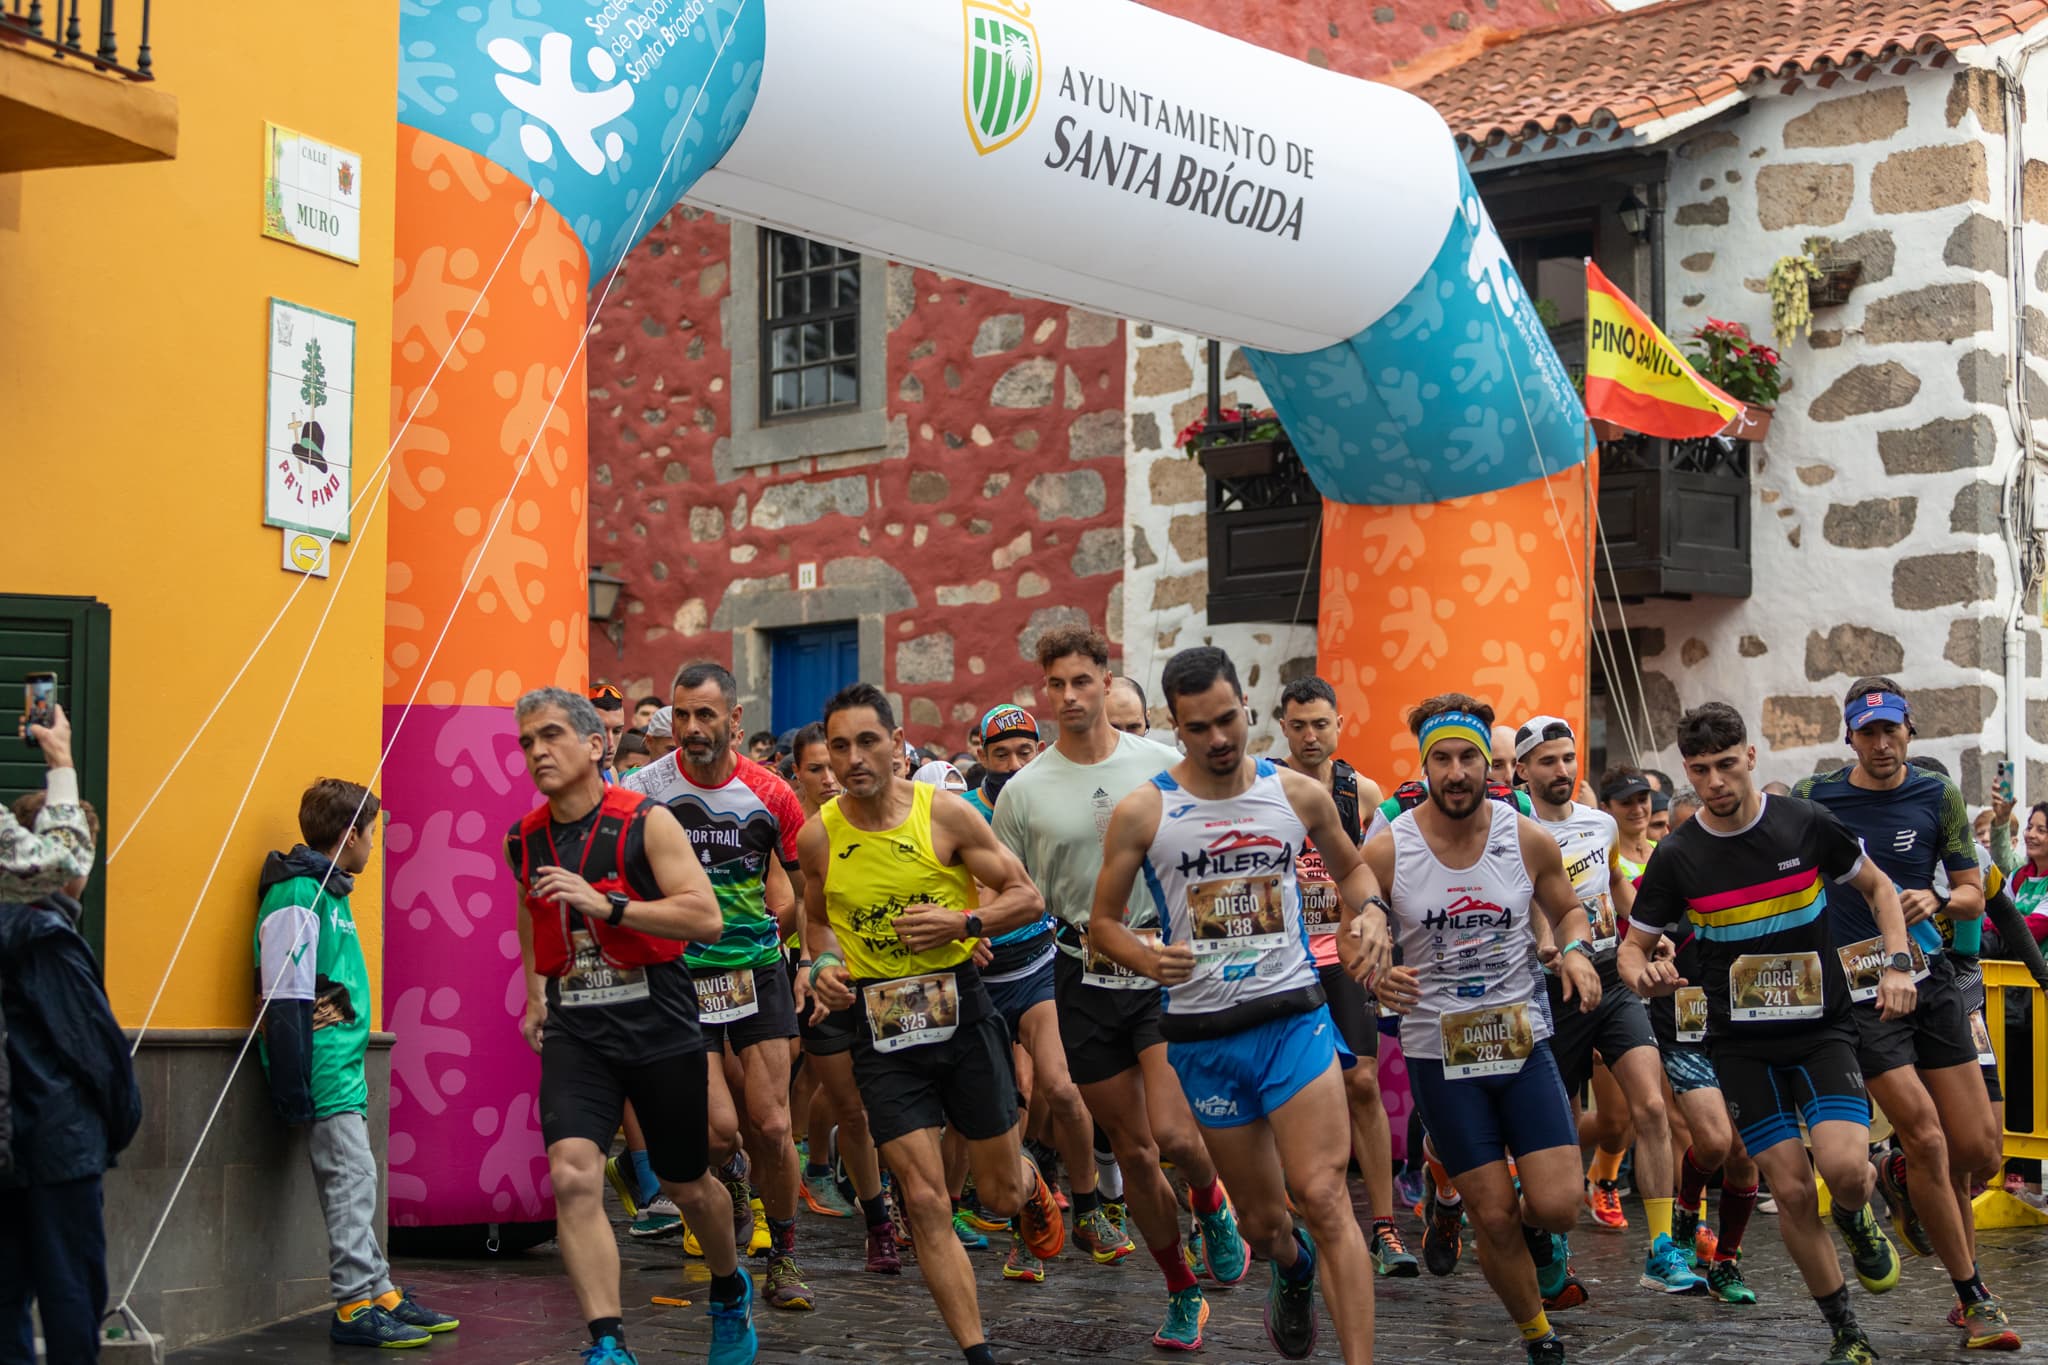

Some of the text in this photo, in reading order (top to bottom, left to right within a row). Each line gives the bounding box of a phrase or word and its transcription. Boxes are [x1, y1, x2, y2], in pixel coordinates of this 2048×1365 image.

[584, 0, 634, 36] Socie
[611, 34, 632, 57] de
[625, 0, 705, 84] Santa Brígida
[1058, 65, 1315, 181] AYUNTAMIENTO DE
[301, 145, 328, 166] CALLE
[1043, 114, 1305, 242] SANTA BRÍGIDA
[296, 202, 341, 238] MURO
[1591, 318, 1636, 359] PINO
[994, 710, 1026, 731] WTF!
[709, 829, 742, 848] TRAIL
[1175, 841, 1292, 878] HILERA
[1566, 847, 1605, 883] porty
[1214, 893, 1260, 917] DIEGO
[1302, 895, 1338, 909] TONIO
[1223, 917, 1253, 937] 138
[1302, 911, 1322, 925] 139
[1421, 907, 1512, 931] HILERA
[583, 969, 613, 989] 306
[1753, 969, 1800, 988] JORGE
[703, 995, 729, 1013] 301
[1764, 990, 1791, 1007] 241
[899, 1012, 928, 1033] 325
[1463, 1022, 1515, 1044] DANIEL
[1476, 1044, 1504, 1063] 282
